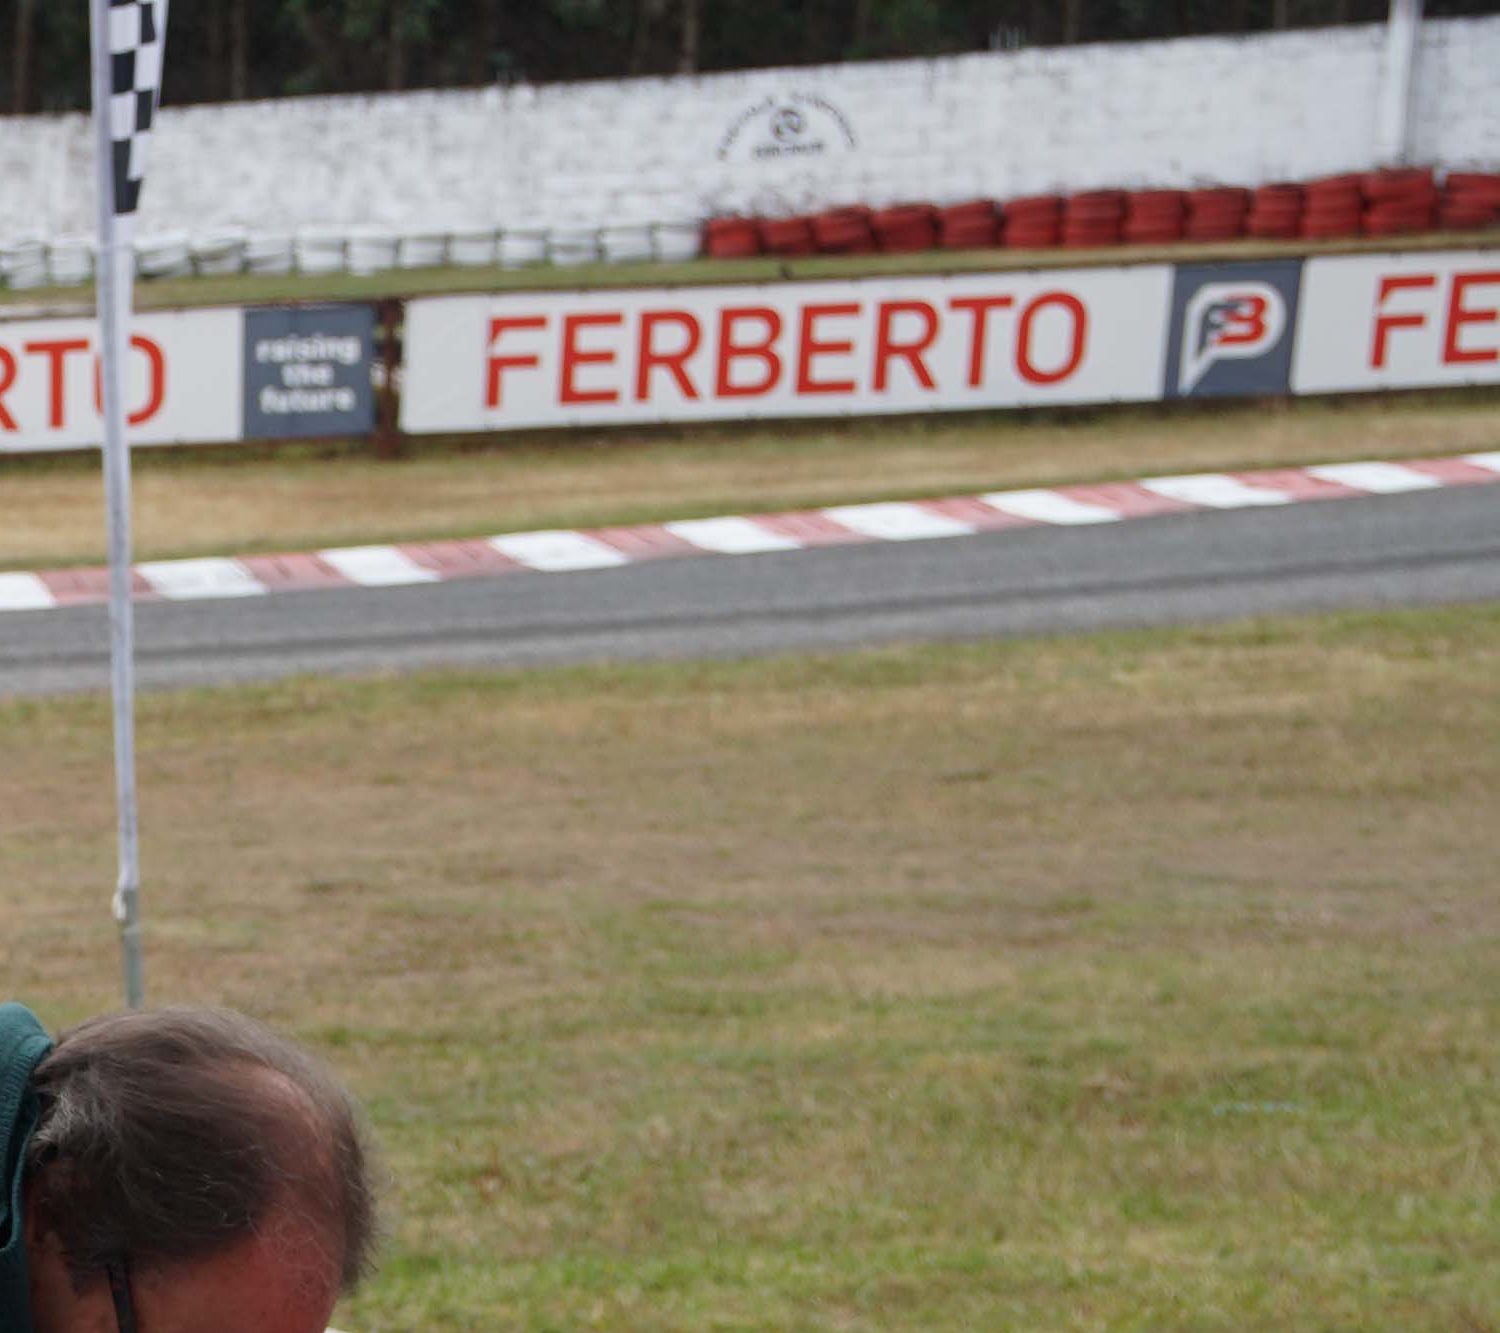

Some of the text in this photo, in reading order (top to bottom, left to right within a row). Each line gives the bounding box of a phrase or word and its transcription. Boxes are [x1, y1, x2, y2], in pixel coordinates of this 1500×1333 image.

[256, 333, 362, 366] raising
[485, 291, 1087, 408] FERBERTO
[282, 364, 334, 387] the
[260, 386, 355, 414] future
